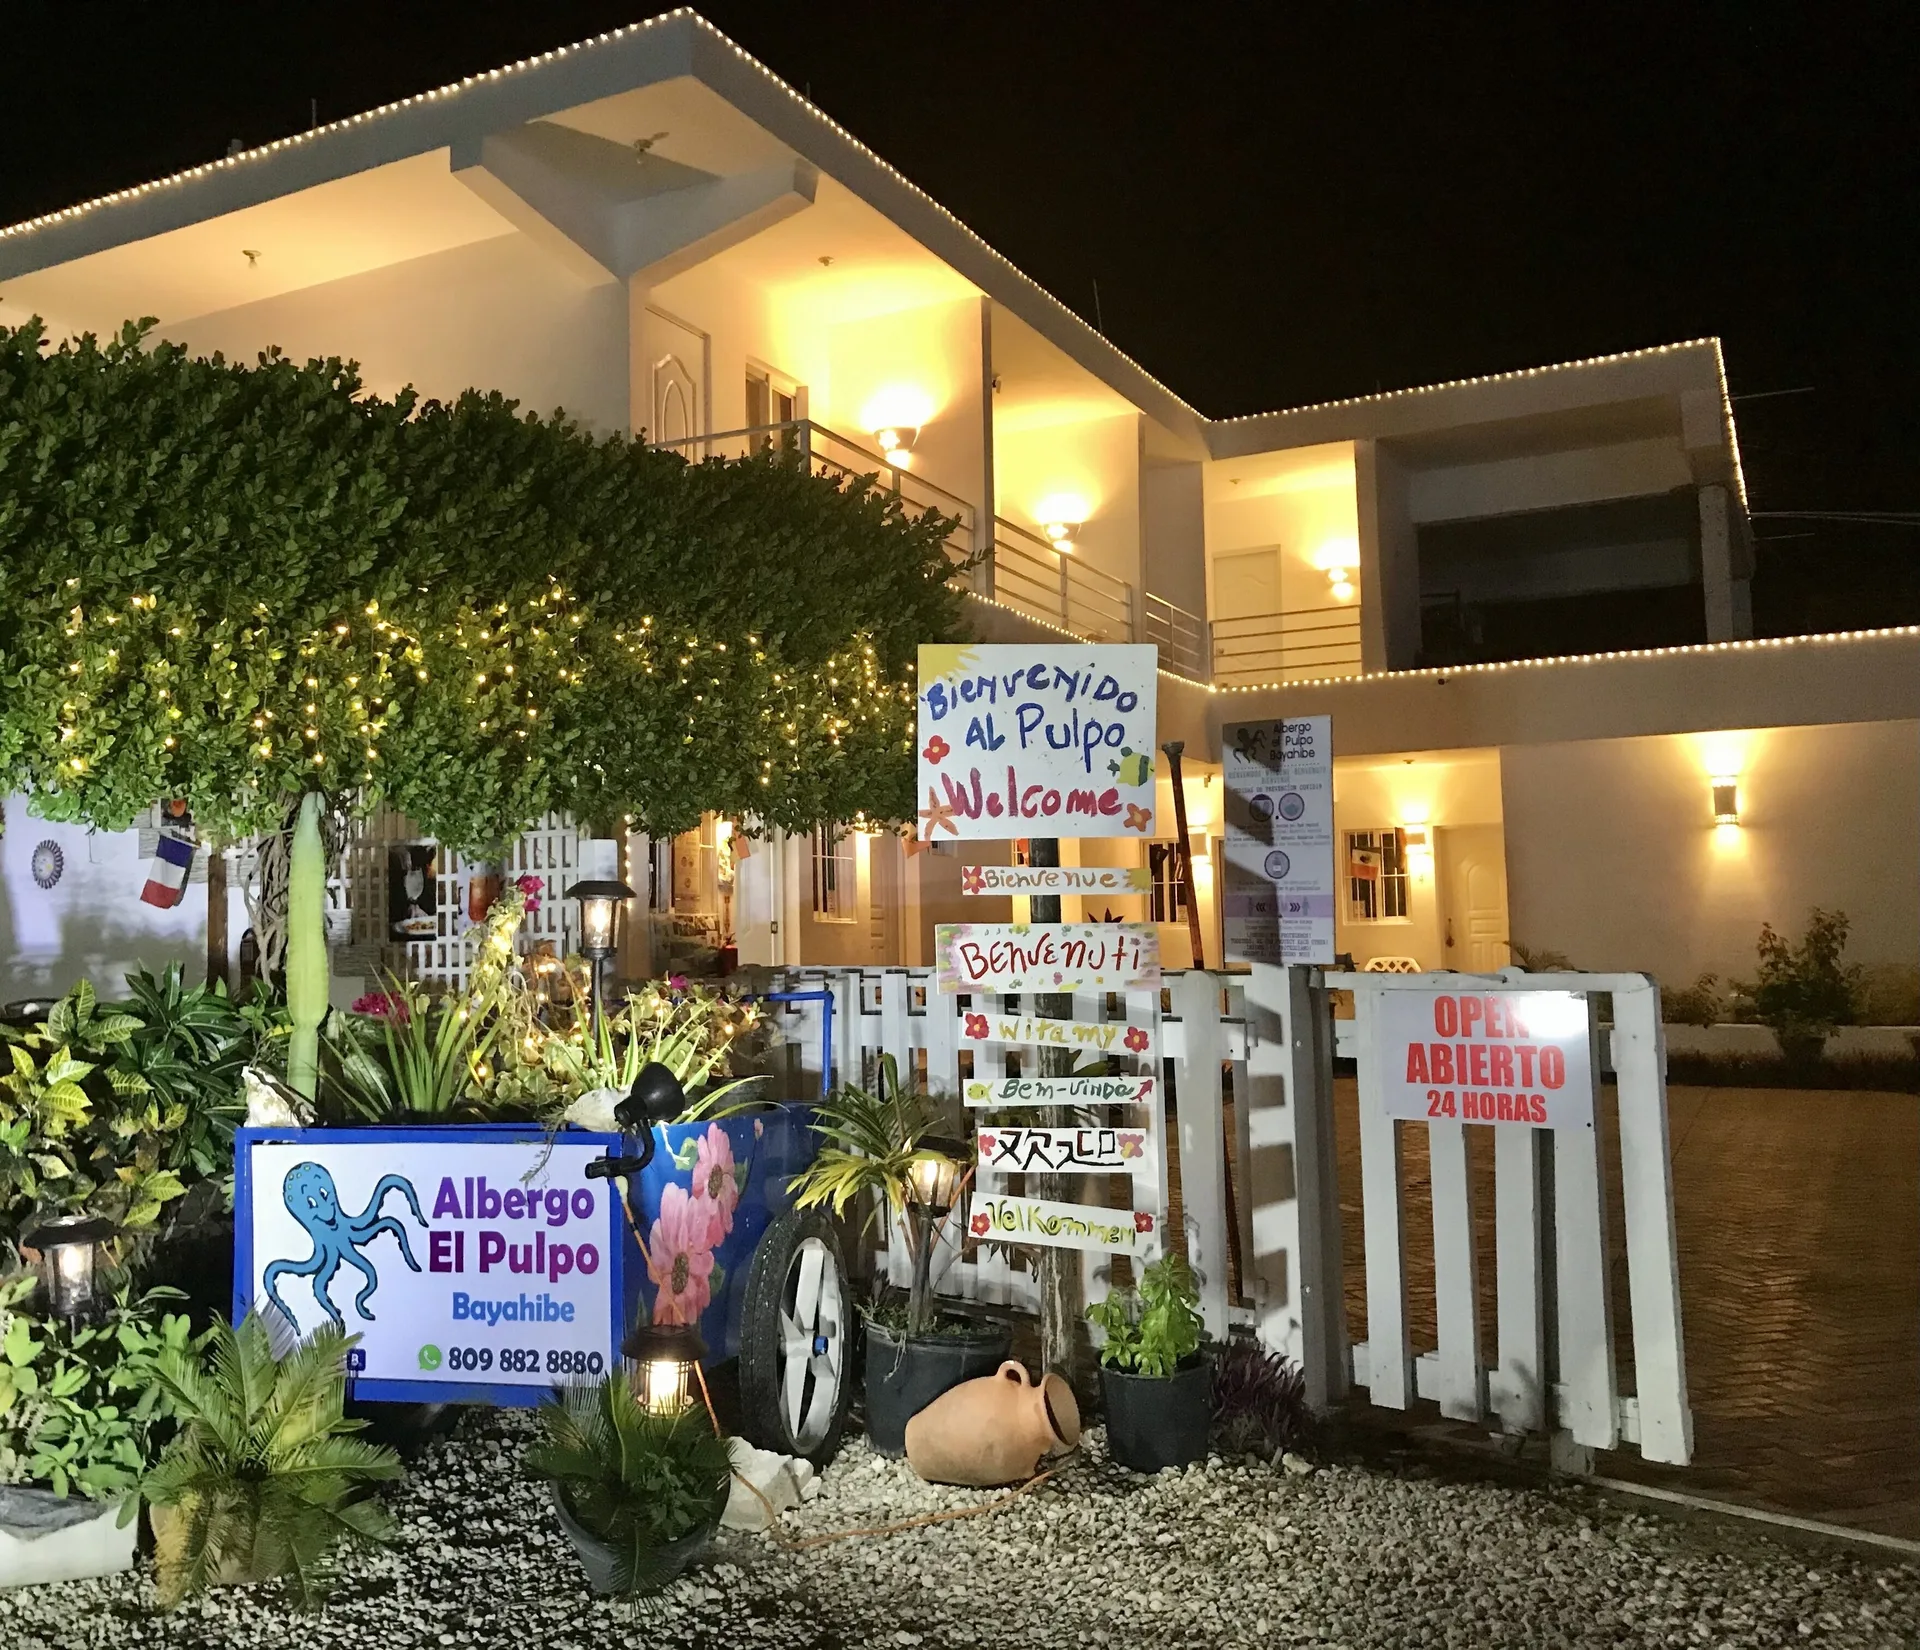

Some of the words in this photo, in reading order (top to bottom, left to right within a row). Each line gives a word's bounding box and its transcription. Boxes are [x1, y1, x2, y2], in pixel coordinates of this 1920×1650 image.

[1015, 702, 1125, 773] Pulpo
[1273, 723, 1312, 734] Albergo
[1285, 735, 1314, 747] Pulpo
[1269, 747, 1316, 762] Bayahibe
[941, 765, 1123, 819] Welcome
[984, 869, 1118, 888] Bienvenue
[1434, 995, 1530, 1039] OPEN
[1406, 1042, 1566, 1090] ABIERTO
[1427, 1089, 1457, 1118] 24
[1463, 1091, 1547, 1123] HORAS
[992, 1128, 1125, 1171] 欢迎
[432, 1176, 595, 1227] Albergo
[429, 1231, 464, 1272] El
[479, 1231, 600, 1283] Pulpo
[452, 1291, 575, 1326] Bayahibe
[448, 1347, 493, 1371] 809
[499, 1347, 541, 1373] 882
[546, 1349, 604, 1374] 8880
